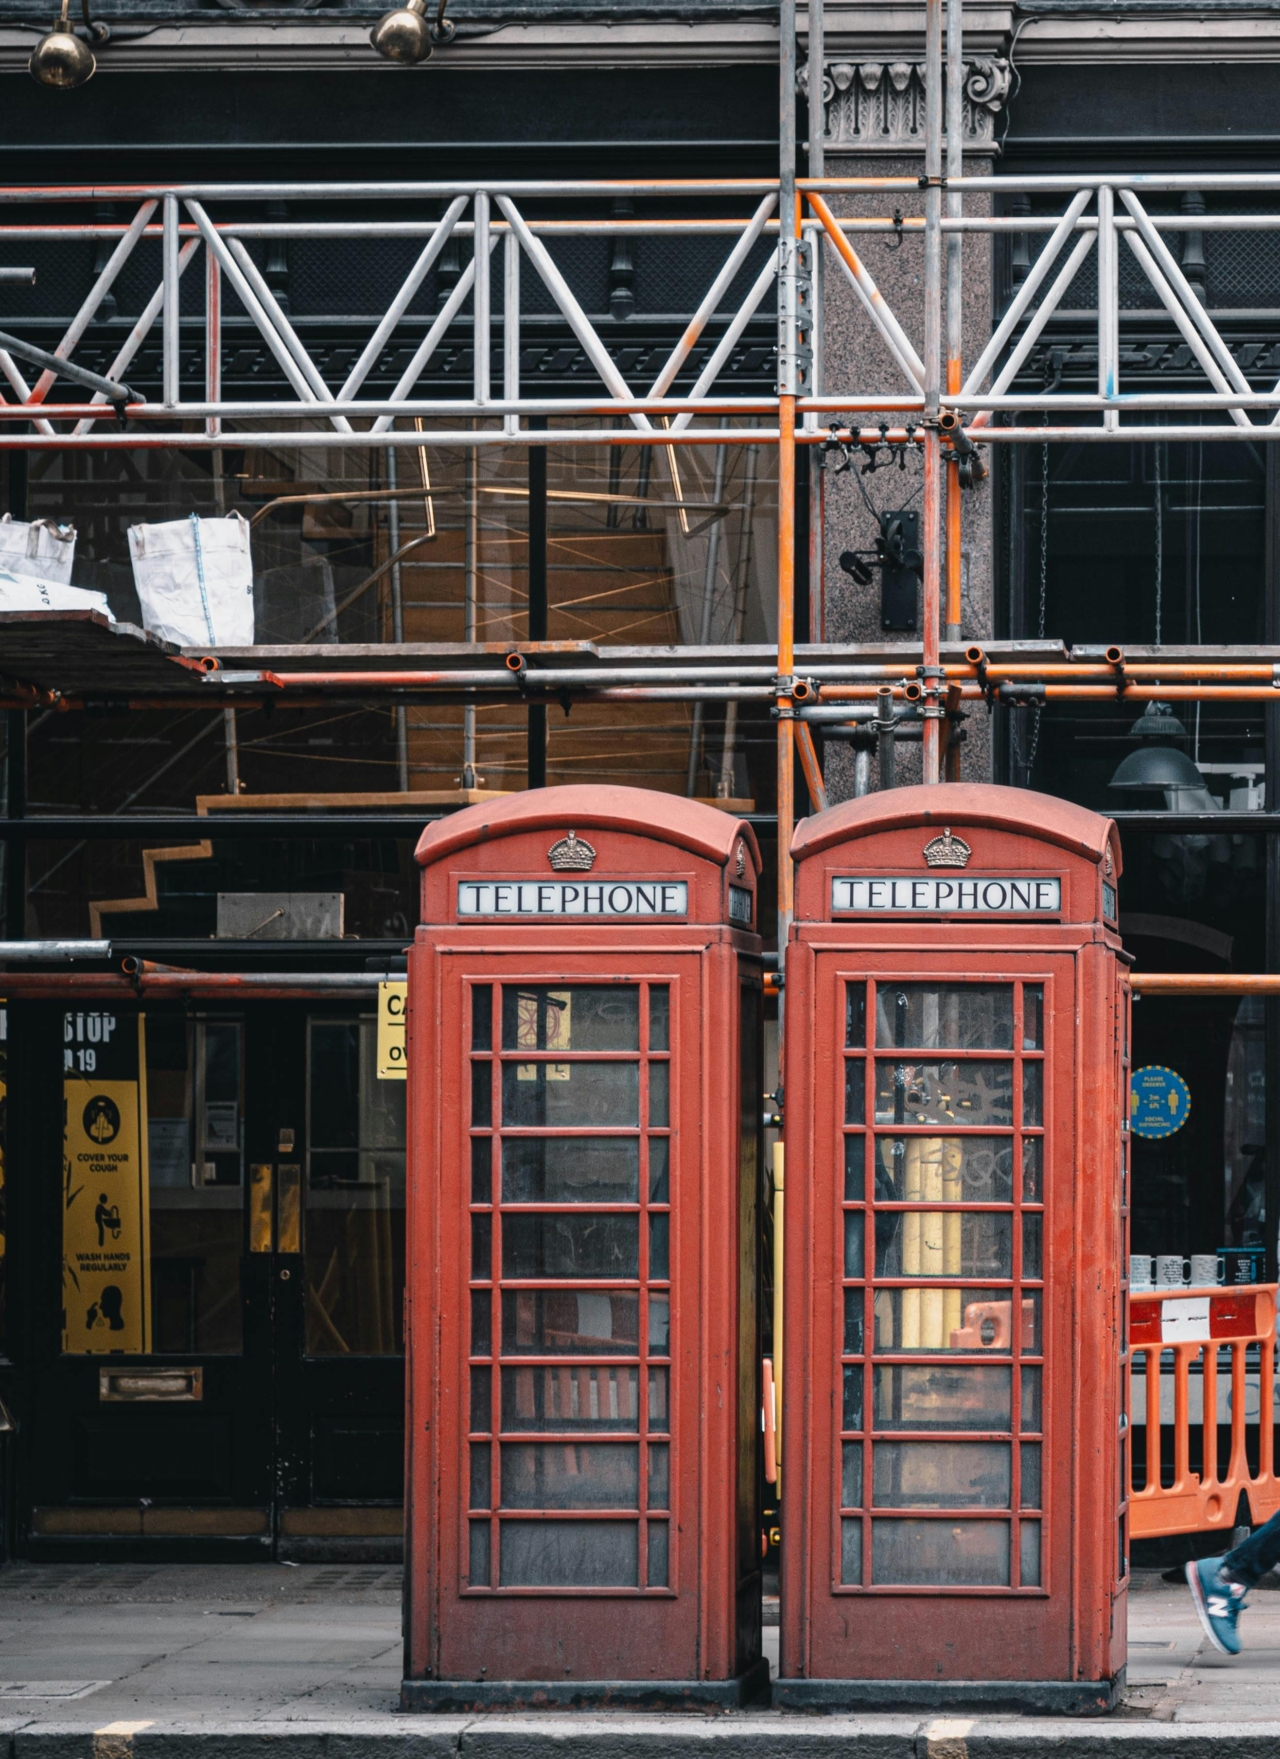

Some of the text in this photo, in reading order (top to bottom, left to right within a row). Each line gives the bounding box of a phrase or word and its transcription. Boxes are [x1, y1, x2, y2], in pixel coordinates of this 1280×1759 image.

[467, 884, 679, 913] TELEPHONE
[842, 880, 1051, 909] TELEPHONE
[77, 1048, 97, 1072] 19
[77, 1153, 129, 1162] COVER YOUR
[89, 1164, 118, 1172] COUGH
[76, 1252, 131, 1261] WASH HANDS
[80, 1262, 128, 1272] REGULARLY
